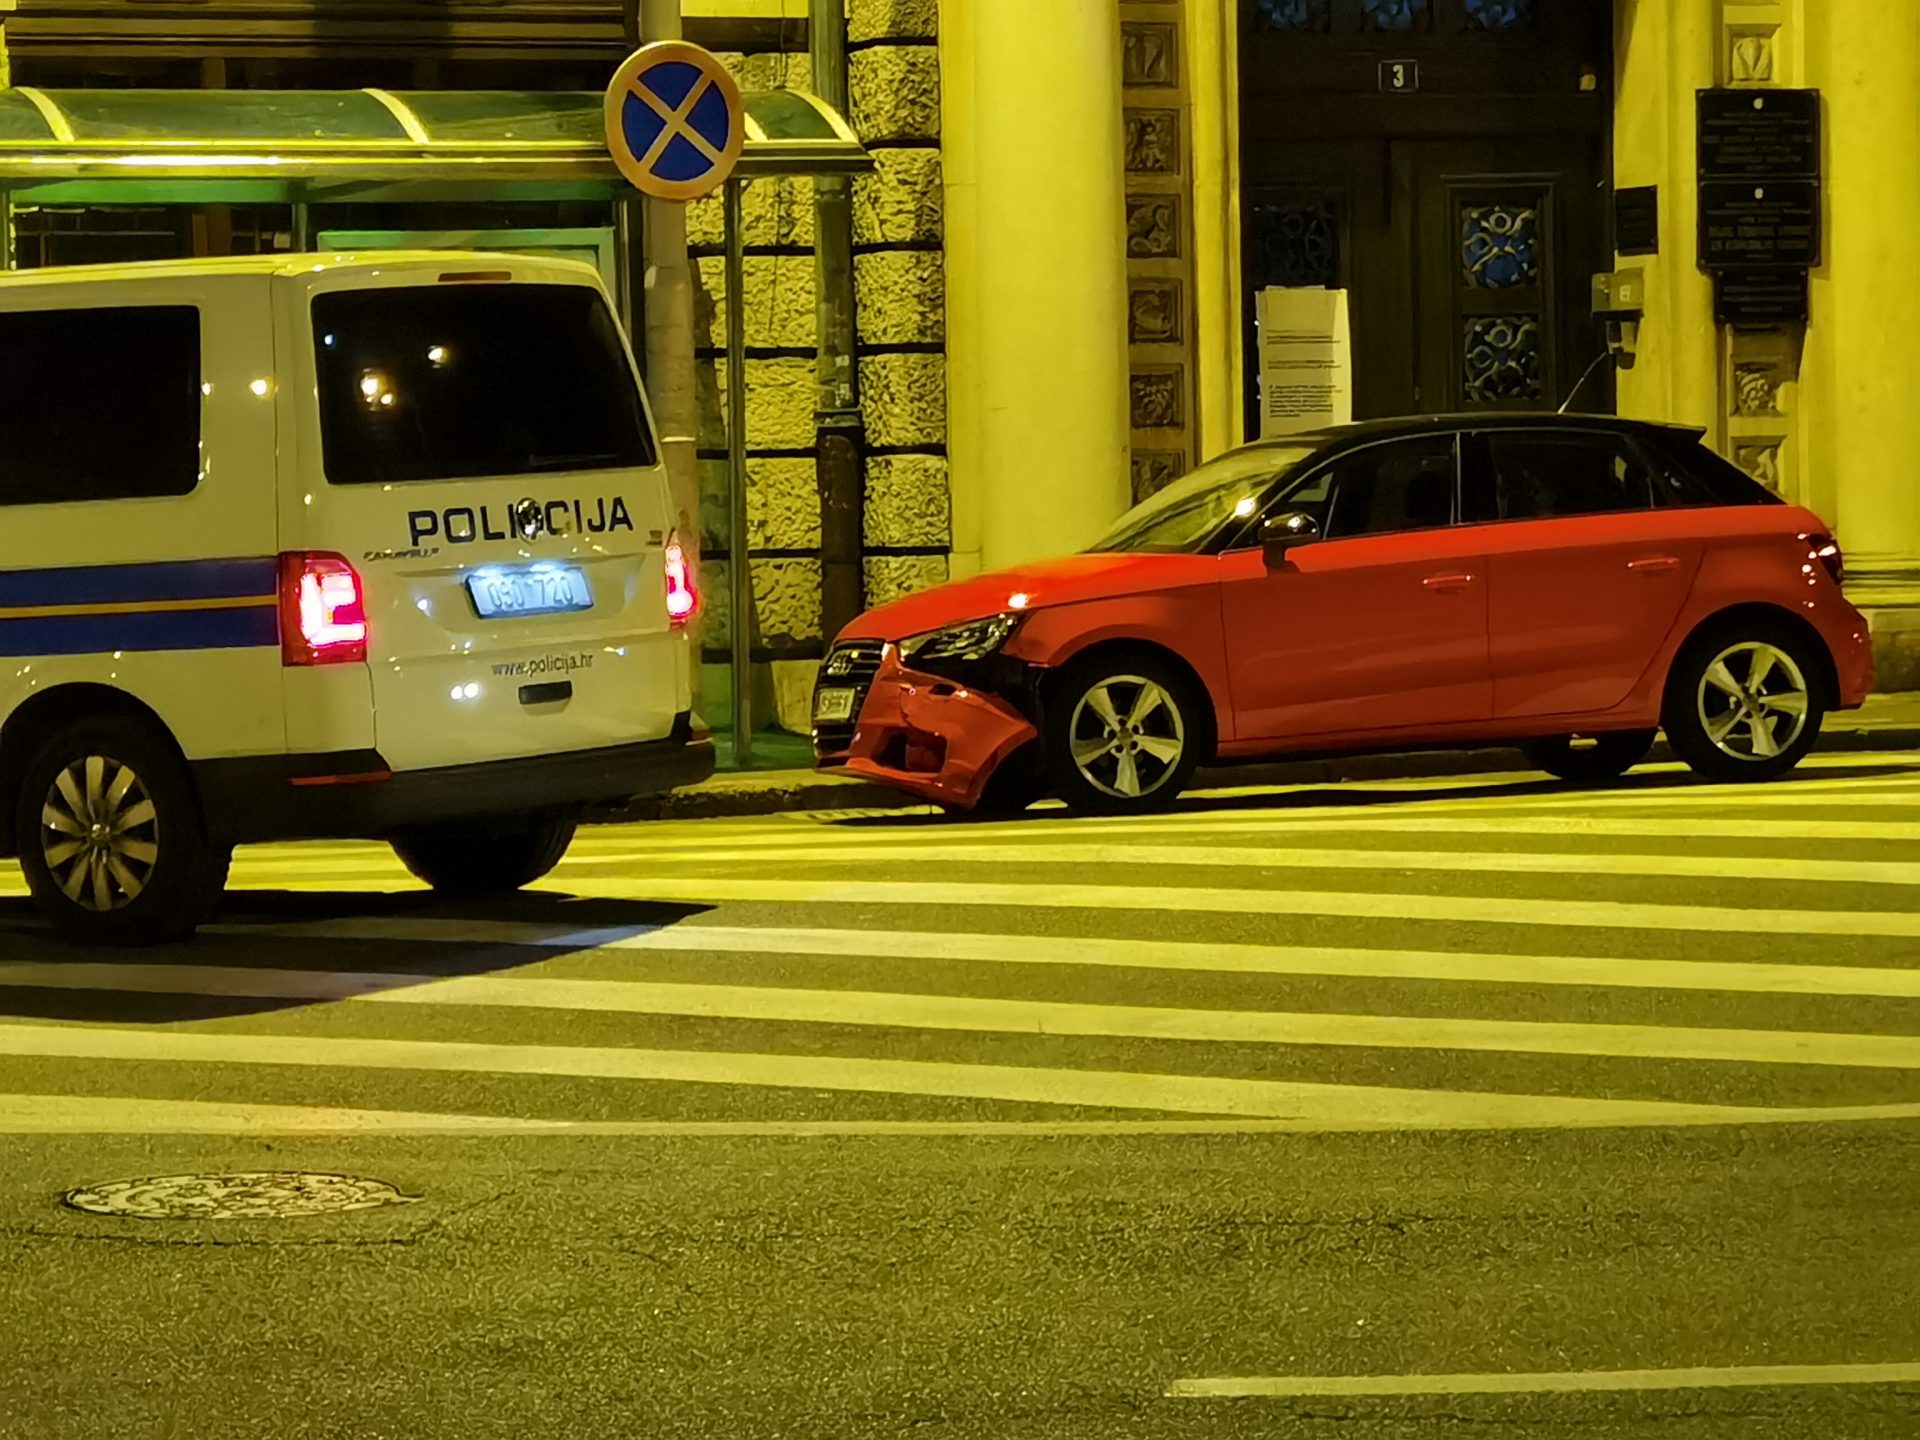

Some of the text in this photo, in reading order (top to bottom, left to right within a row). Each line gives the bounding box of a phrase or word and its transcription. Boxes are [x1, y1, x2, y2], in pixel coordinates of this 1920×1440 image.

[1392, 64, 1404, 88] 3
[408, 496, 634, 547] POLICIJA
[491, 652, 593, 678] www.policija.hr
